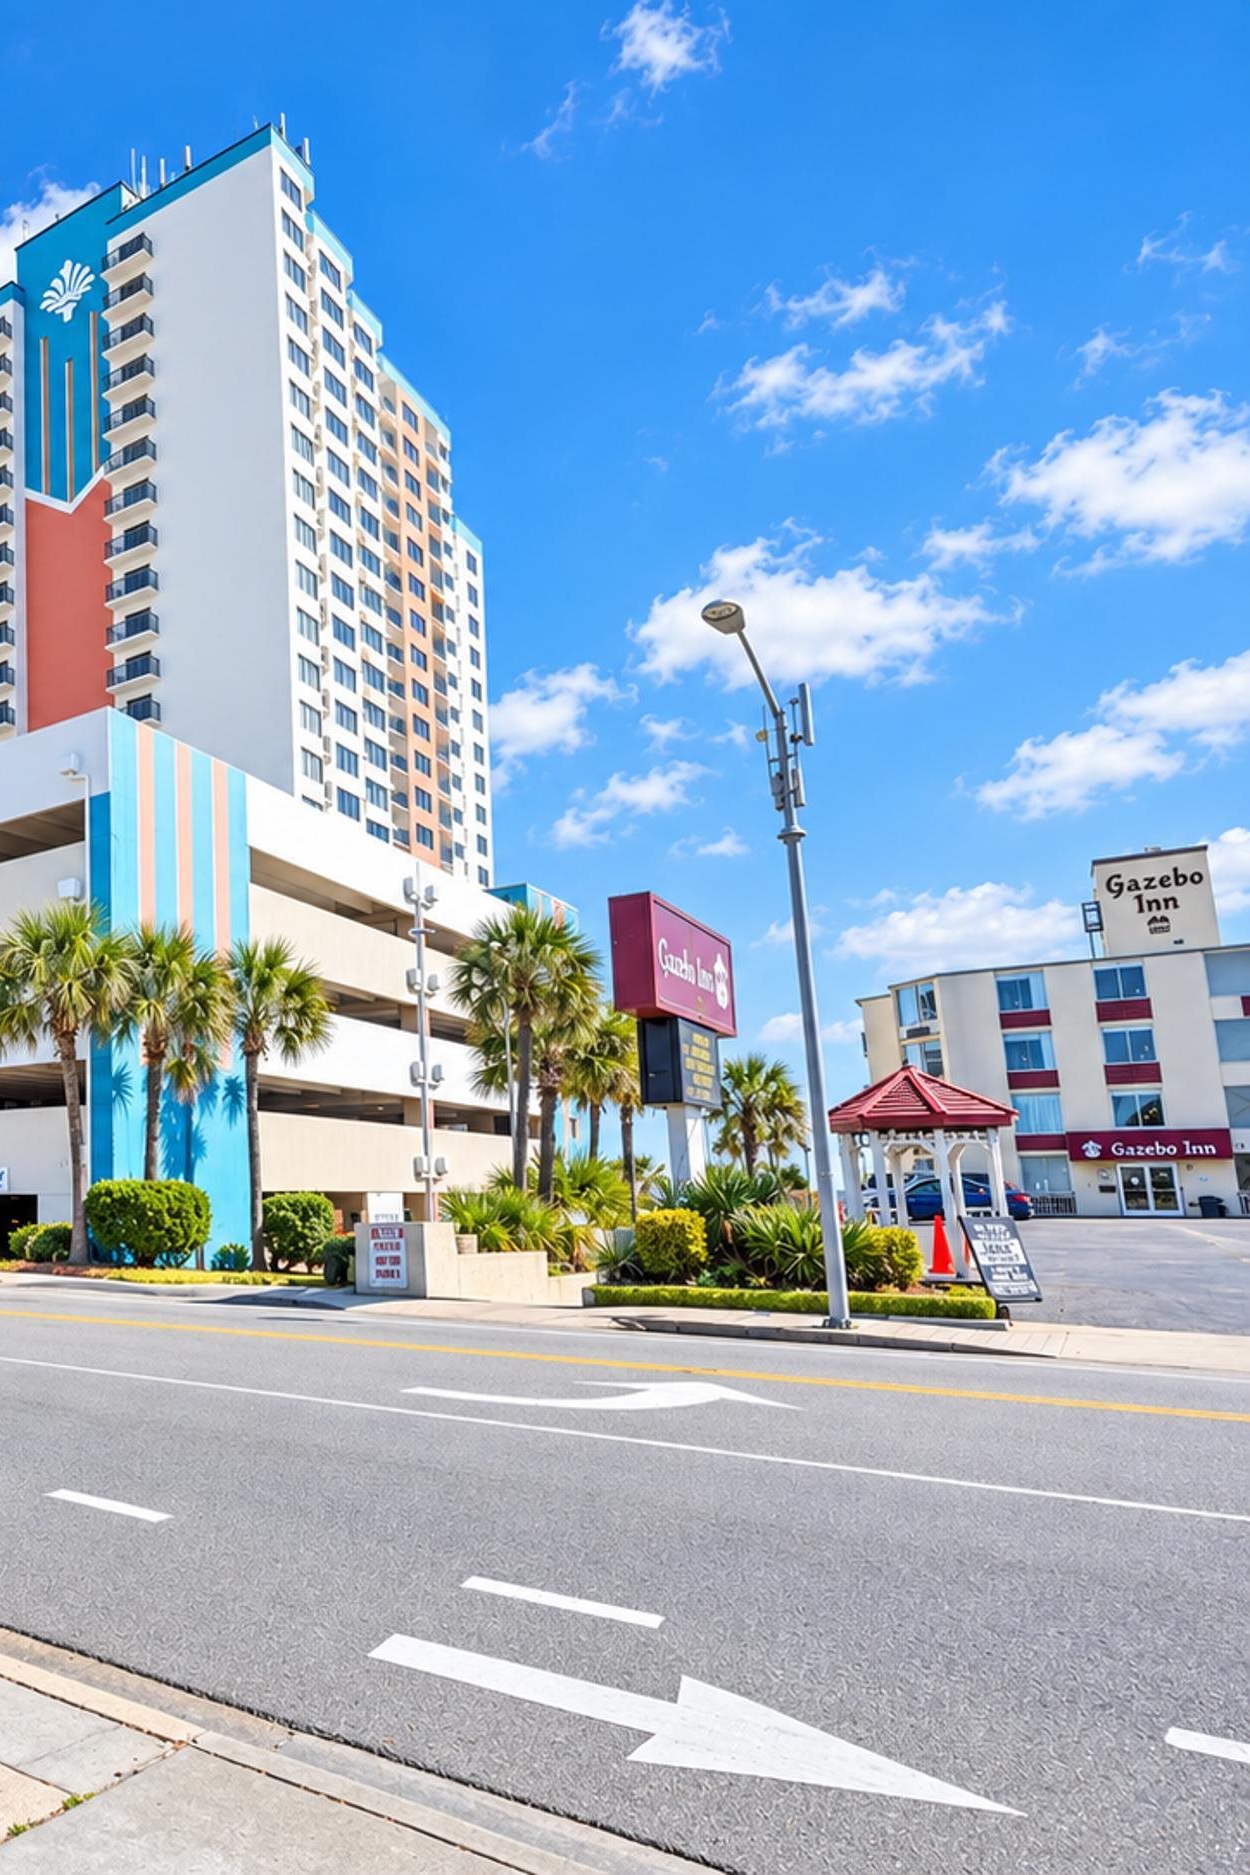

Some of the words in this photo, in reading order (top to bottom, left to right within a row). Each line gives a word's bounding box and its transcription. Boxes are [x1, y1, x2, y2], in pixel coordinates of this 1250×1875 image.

[1106, 867, 1203, 899] Gazebo
[1133, 894, 1180, 913] Inn
[1111, 1141, 1177, 1156] Gazebo
[1182, 1139, 1216, 1155] Inn
